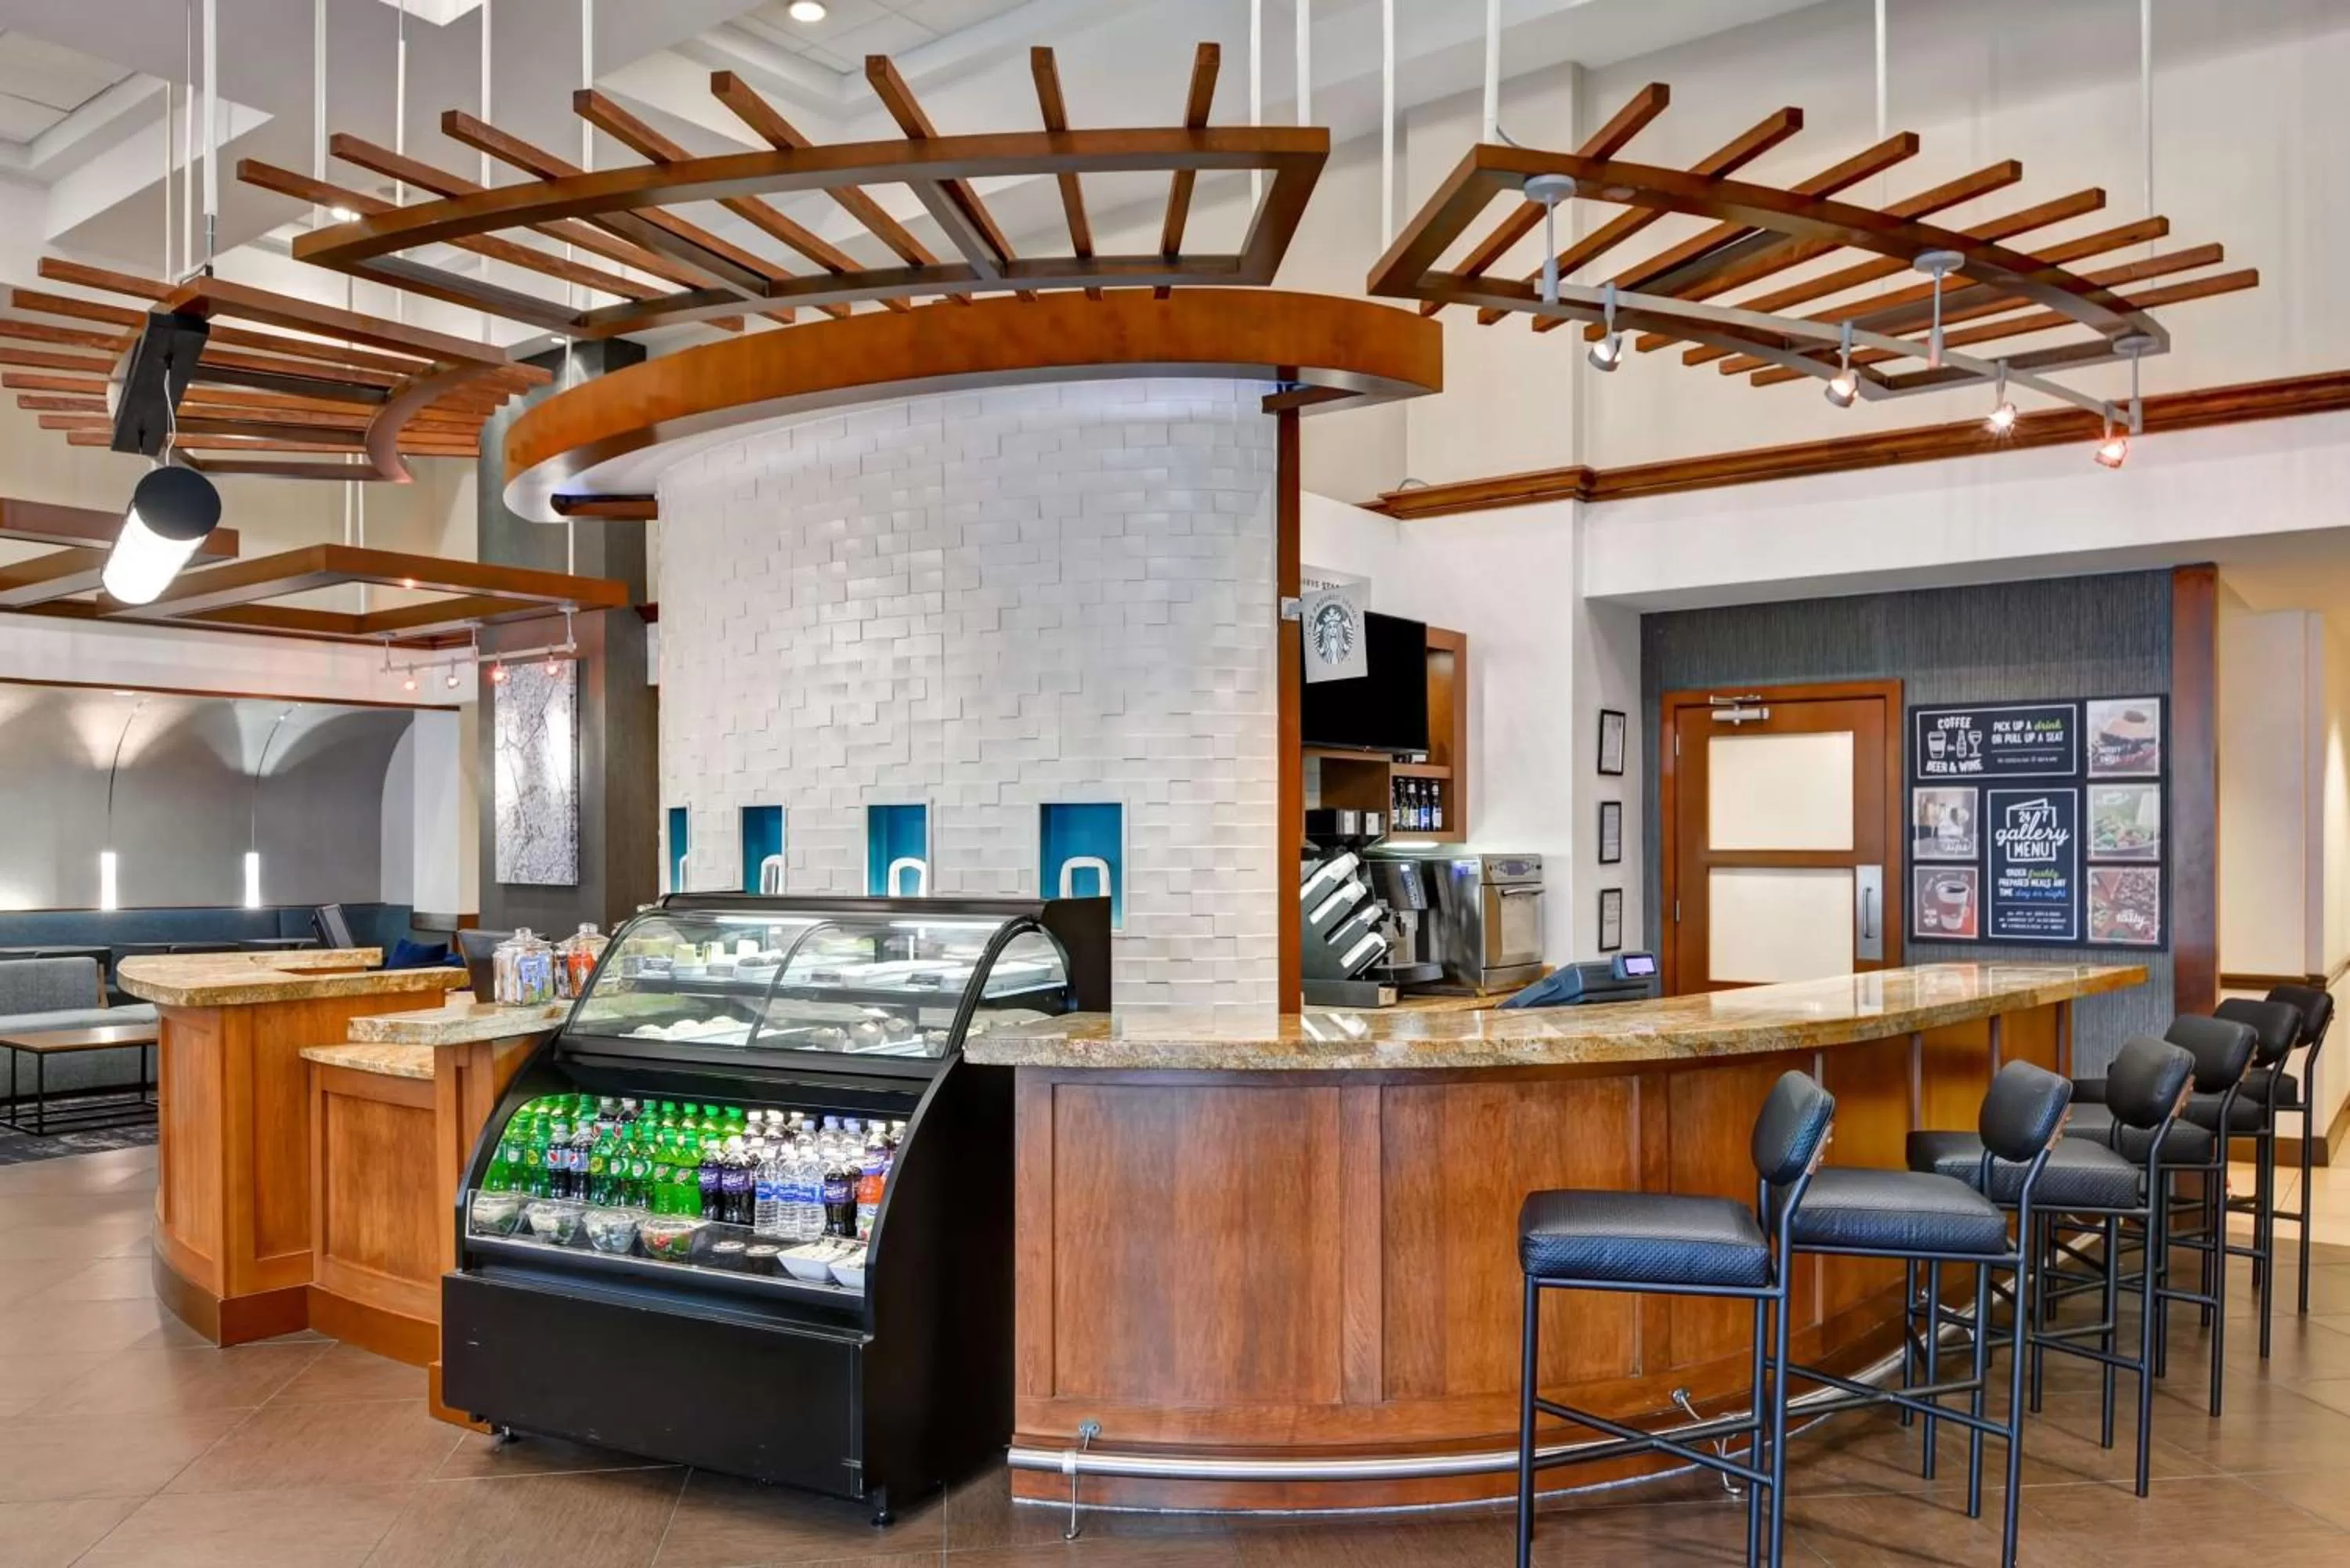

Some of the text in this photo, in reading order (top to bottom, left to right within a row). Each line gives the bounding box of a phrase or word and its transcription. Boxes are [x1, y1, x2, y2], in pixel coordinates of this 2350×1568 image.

[1937, 716, 1972, 729] COFFEE
[1993, 718, 2063, 732] PICK UP A drink
[2004, 733, 2023, 744] PULL
[2023, 732, 2036, 743] UP
[2037, 732, 2044, 743] A
[2045, 730, 2064, 742] SEAT
[1926, 761, 1947, 773] BEER
[1958, 759, 1983, 773] WINE
[1995, 811, 2070, 846] gallery
[2014, 841, 2050, 857] MENU
[1999, 887, 2013, 897] TIME
